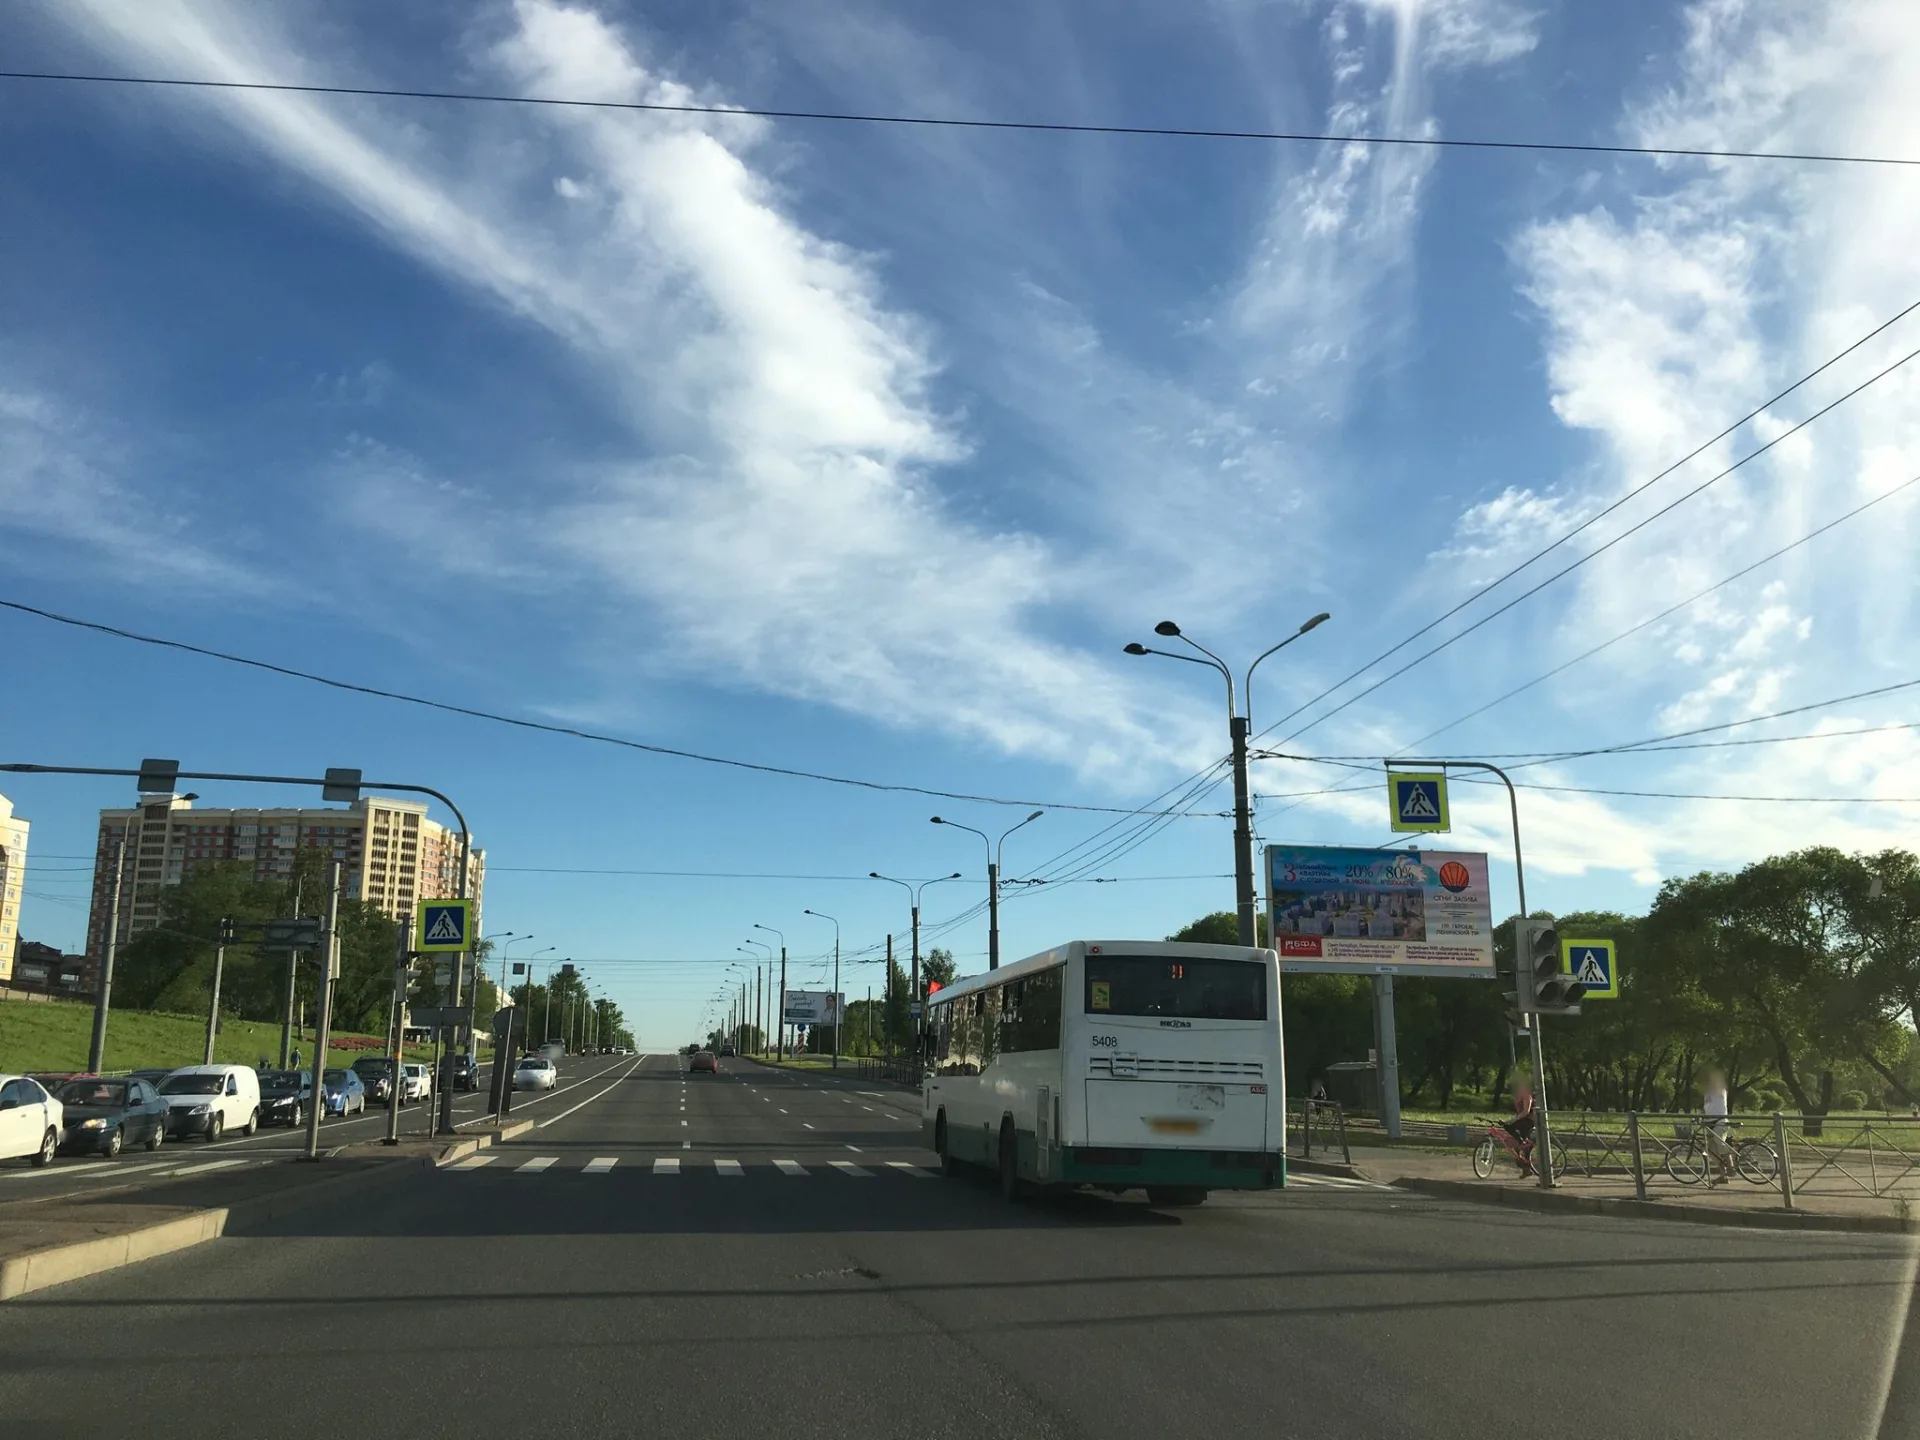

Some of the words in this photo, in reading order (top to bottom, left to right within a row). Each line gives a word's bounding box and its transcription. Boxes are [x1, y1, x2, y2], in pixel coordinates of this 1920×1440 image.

[1284, 863, 1296, 882] 3
[1345, 864, 1374, 878] 20%
[1386, 865, 1414, 880] 80%
[1092, 1036, 1118, 1047] 5408
